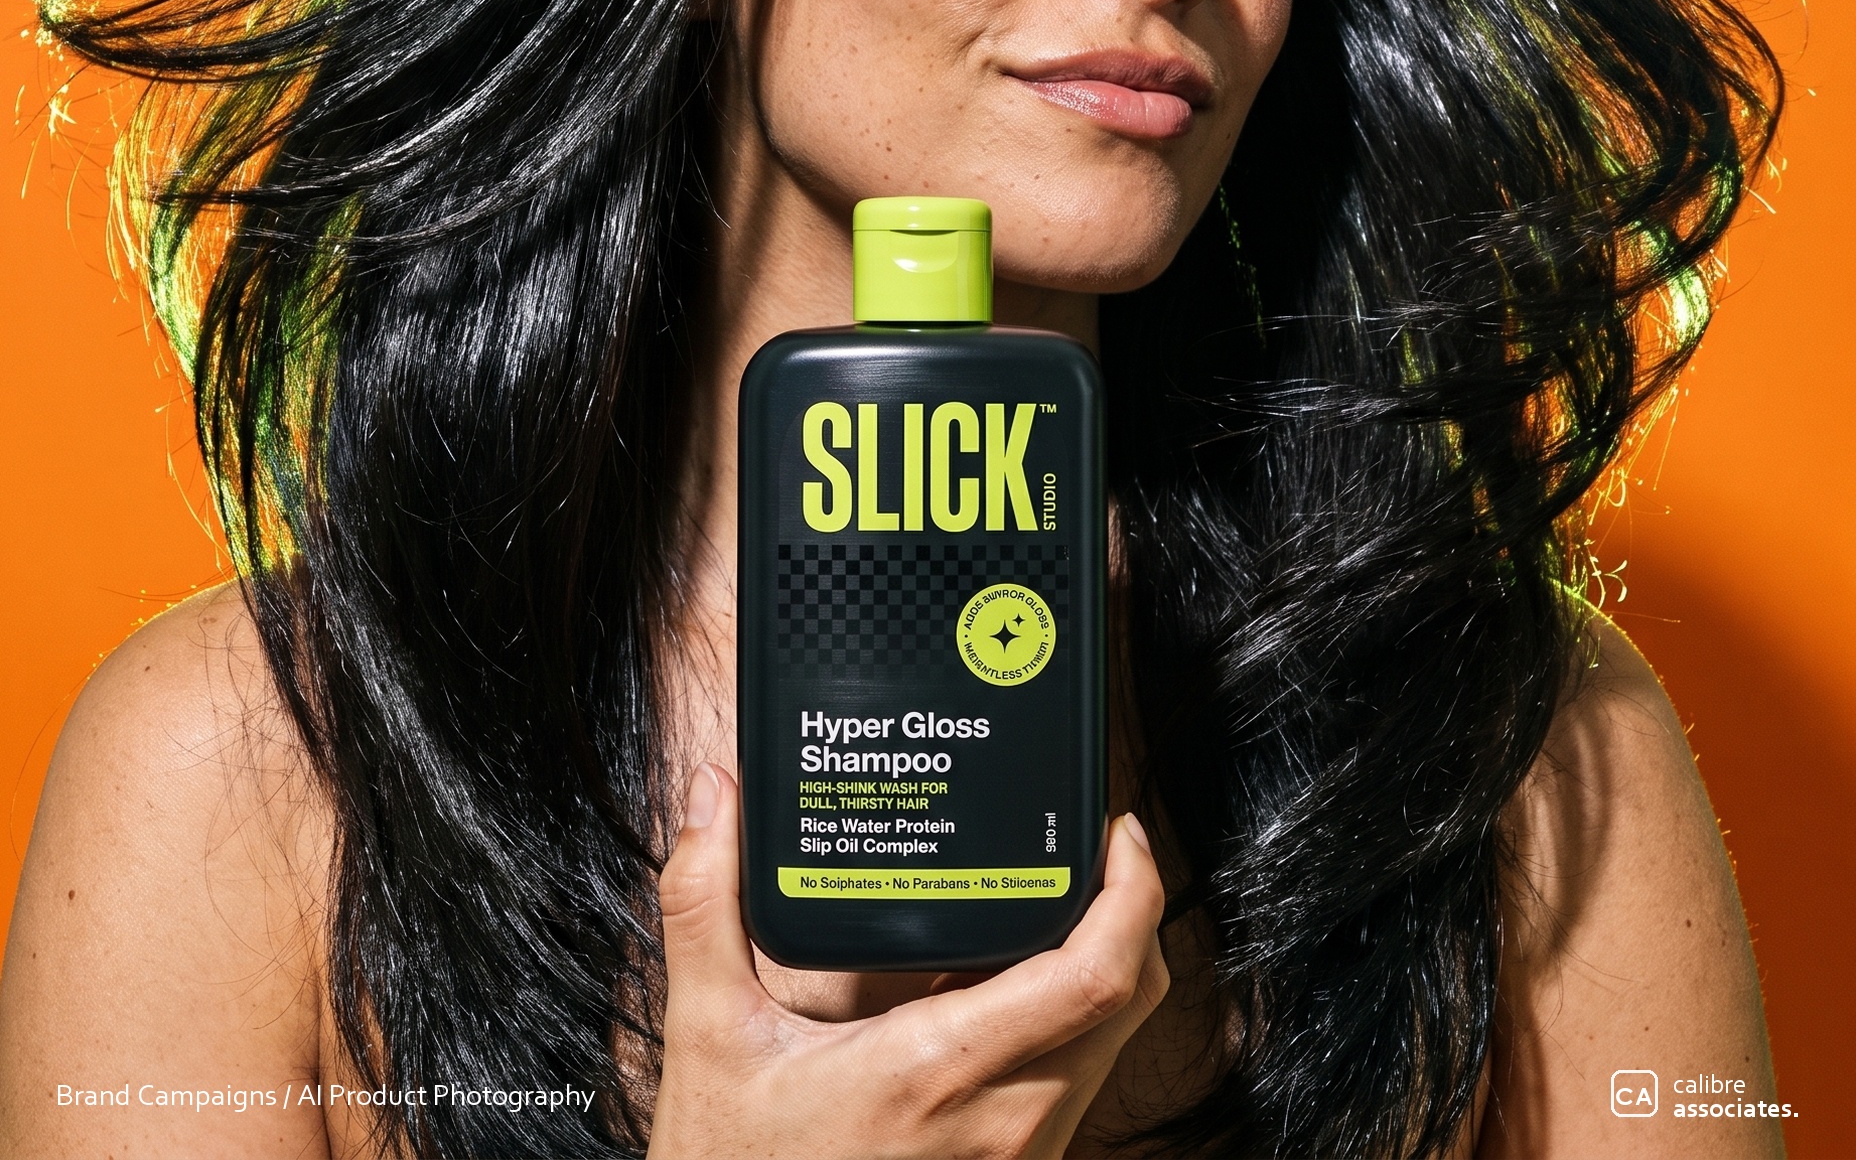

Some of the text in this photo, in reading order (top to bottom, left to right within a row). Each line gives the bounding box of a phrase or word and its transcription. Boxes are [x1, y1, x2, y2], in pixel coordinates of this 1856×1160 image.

[803, 401, 1038, 532] SLICK
[1044, 473, 1056, 530] STUDIO
[802, 711, 990, 743] Hyper Gloss
[801, 745, 951, 778] Shampoo
[800, 782, 947, 794] HIGH-SHINK WASH FOR
[800, 797, 928, 810] DULL, THIRSTY HAIR
[801, 818, 954, 833] Rice Water Protein
[801, 838, 938, 856] Slip Oil Complex
[801, 877, 817, 888] No
[893, 878, 909, 889] No
[914, 878, 970, 889] Parabans
[982, 878, 998, 888] No
